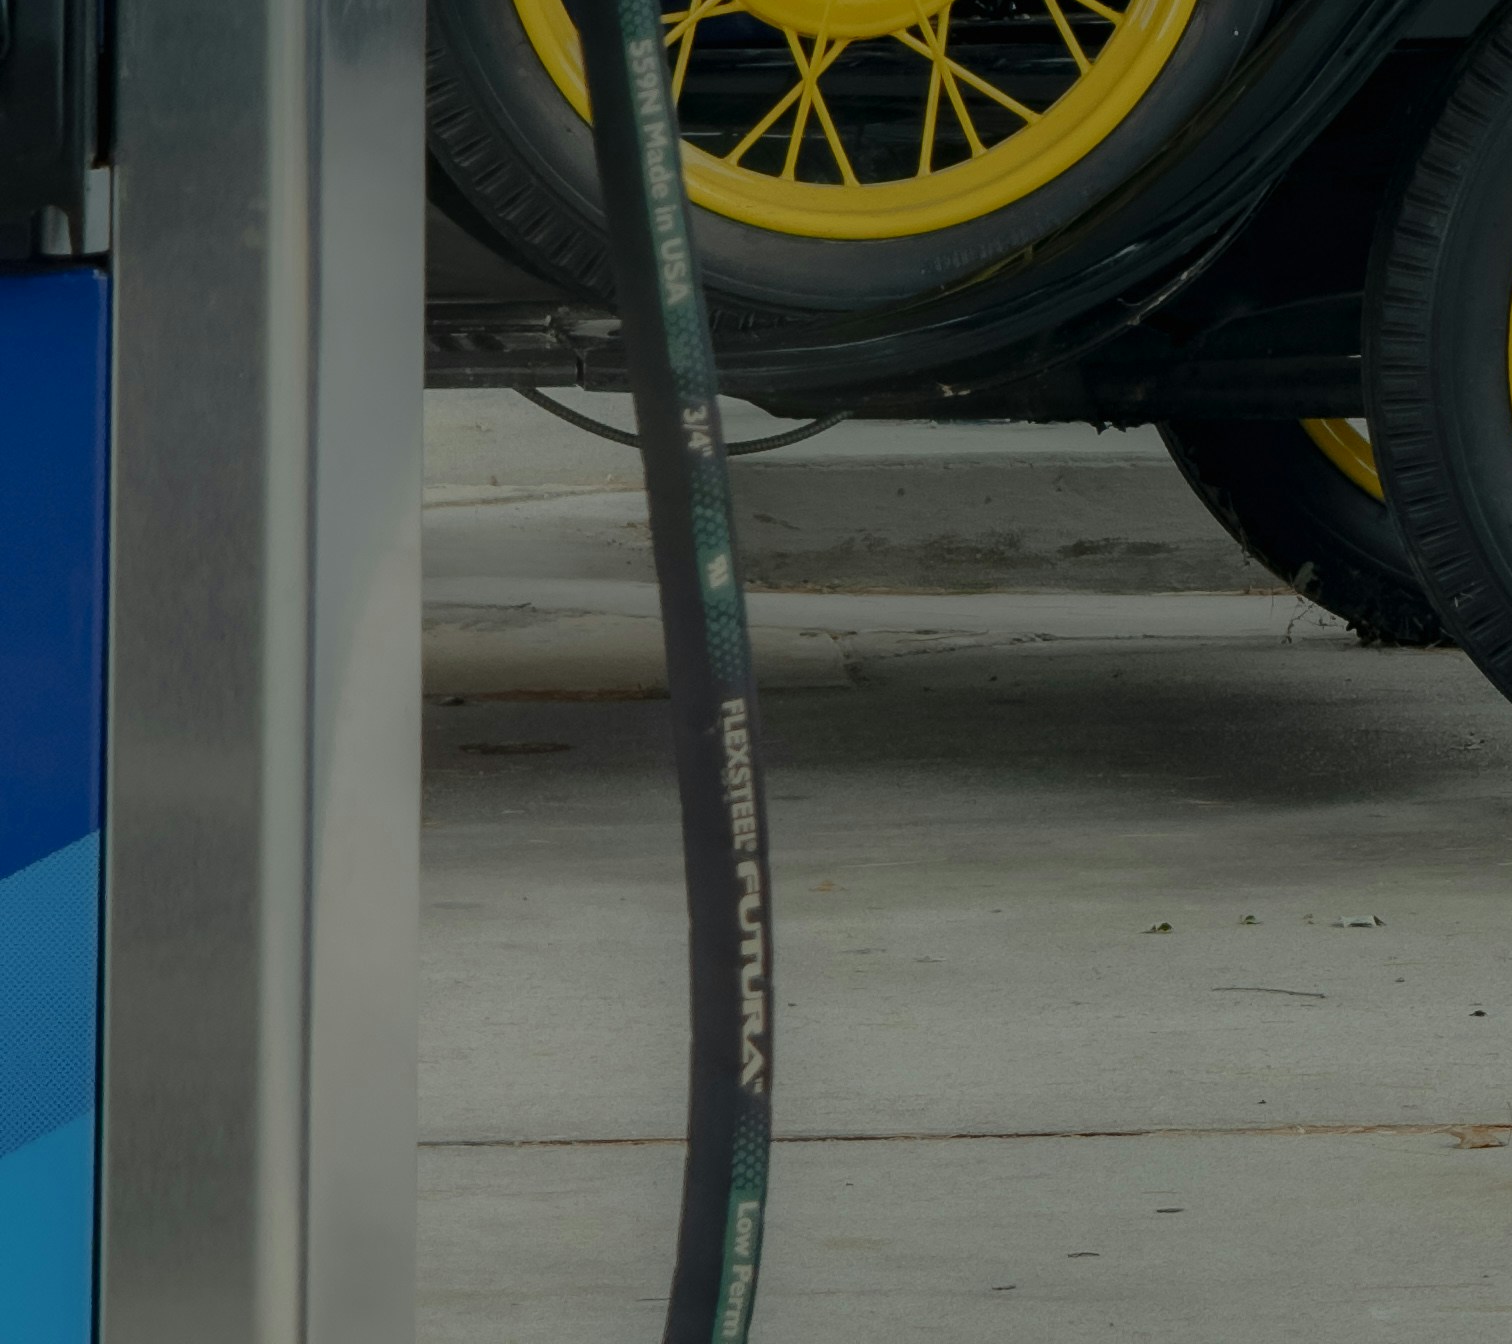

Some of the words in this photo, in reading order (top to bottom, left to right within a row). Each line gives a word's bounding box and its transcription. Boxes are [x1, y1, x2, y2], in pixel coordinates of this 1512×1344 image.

[628, 38, 664, 115] 559N
[642, 123, 674, 200] Made
[655, 205, 677, 232] in
[659, 237, 691, 306] USA
[721, 697, 757, 850] FLEXSTEEL
[736, 860, 766, 1088] FUTURA
[733, 1200, 760, 1256] Low
[722, 1264, 753, 1337] Perm
